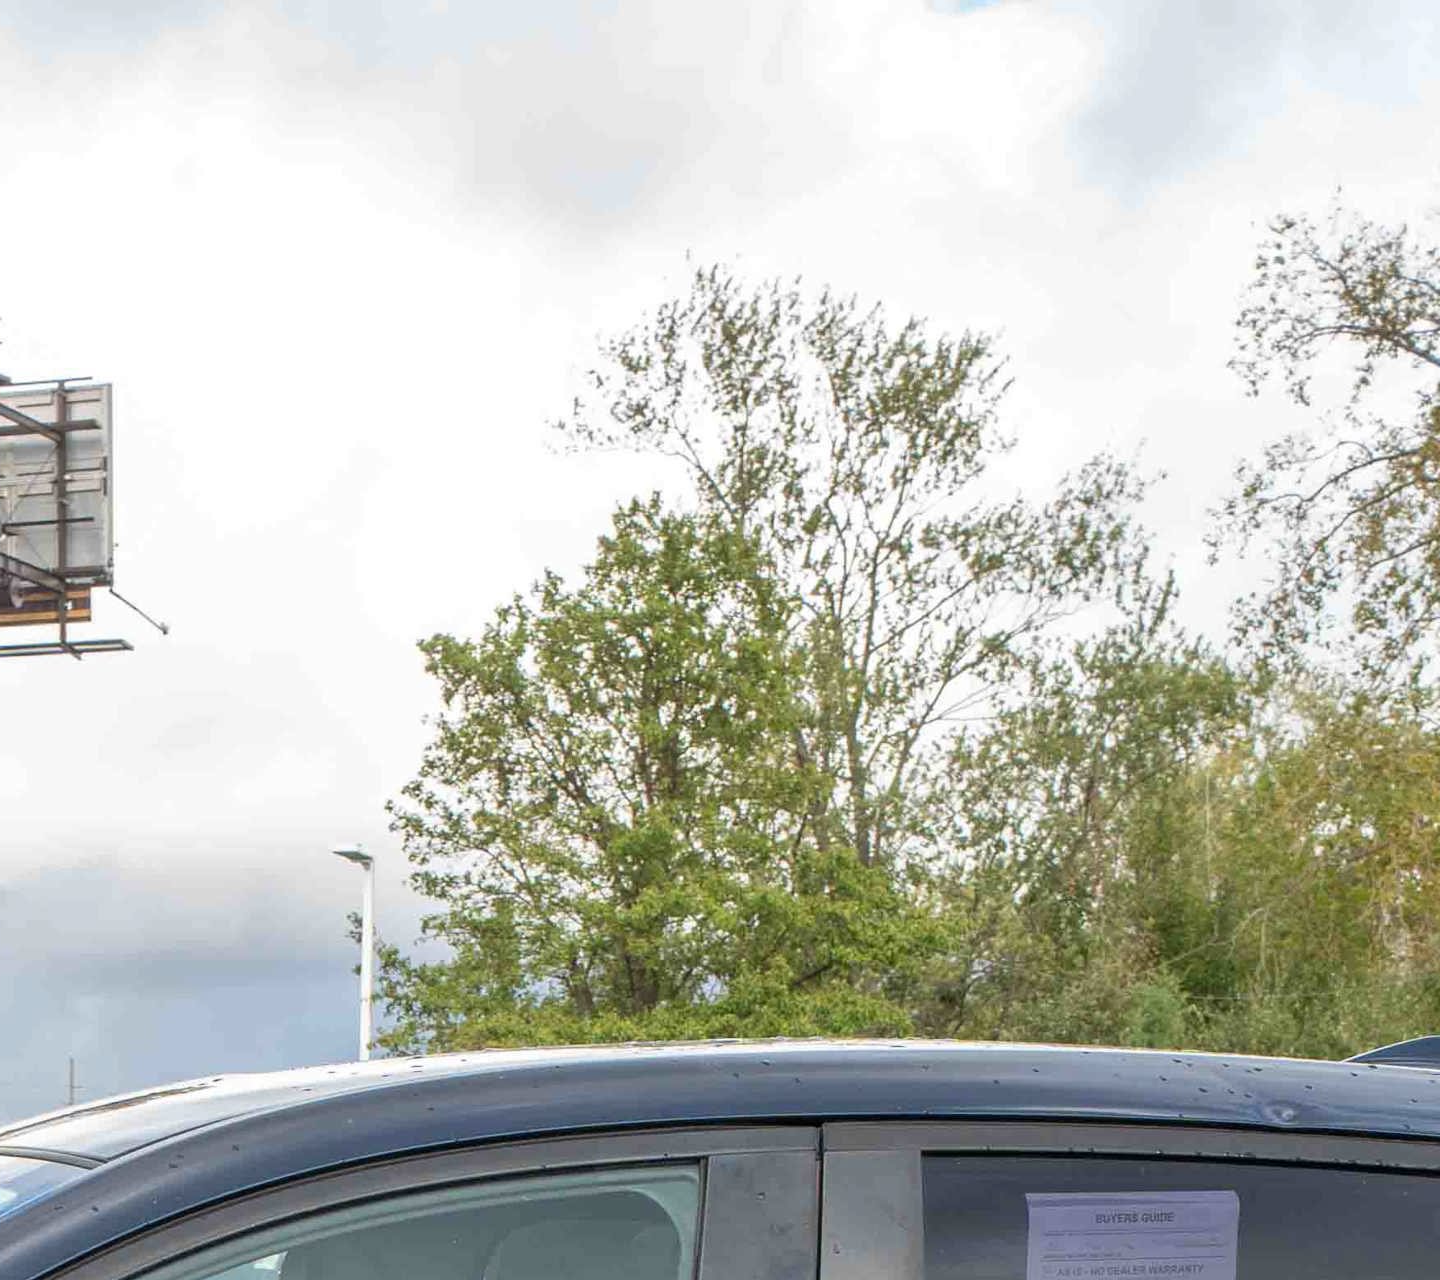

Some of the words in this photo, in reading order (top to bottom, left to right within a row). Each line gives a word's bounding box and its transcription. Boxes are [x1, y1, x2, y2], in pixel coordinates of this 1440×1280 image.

[1095, 1213, 1138, 1224] BUYERS
[1141, 1212, 1174, 1223] GUIDE
[1107, 1264, 1146, 1276] DEALER
[1148, 1263, 1204, 1275] WARRANTY
